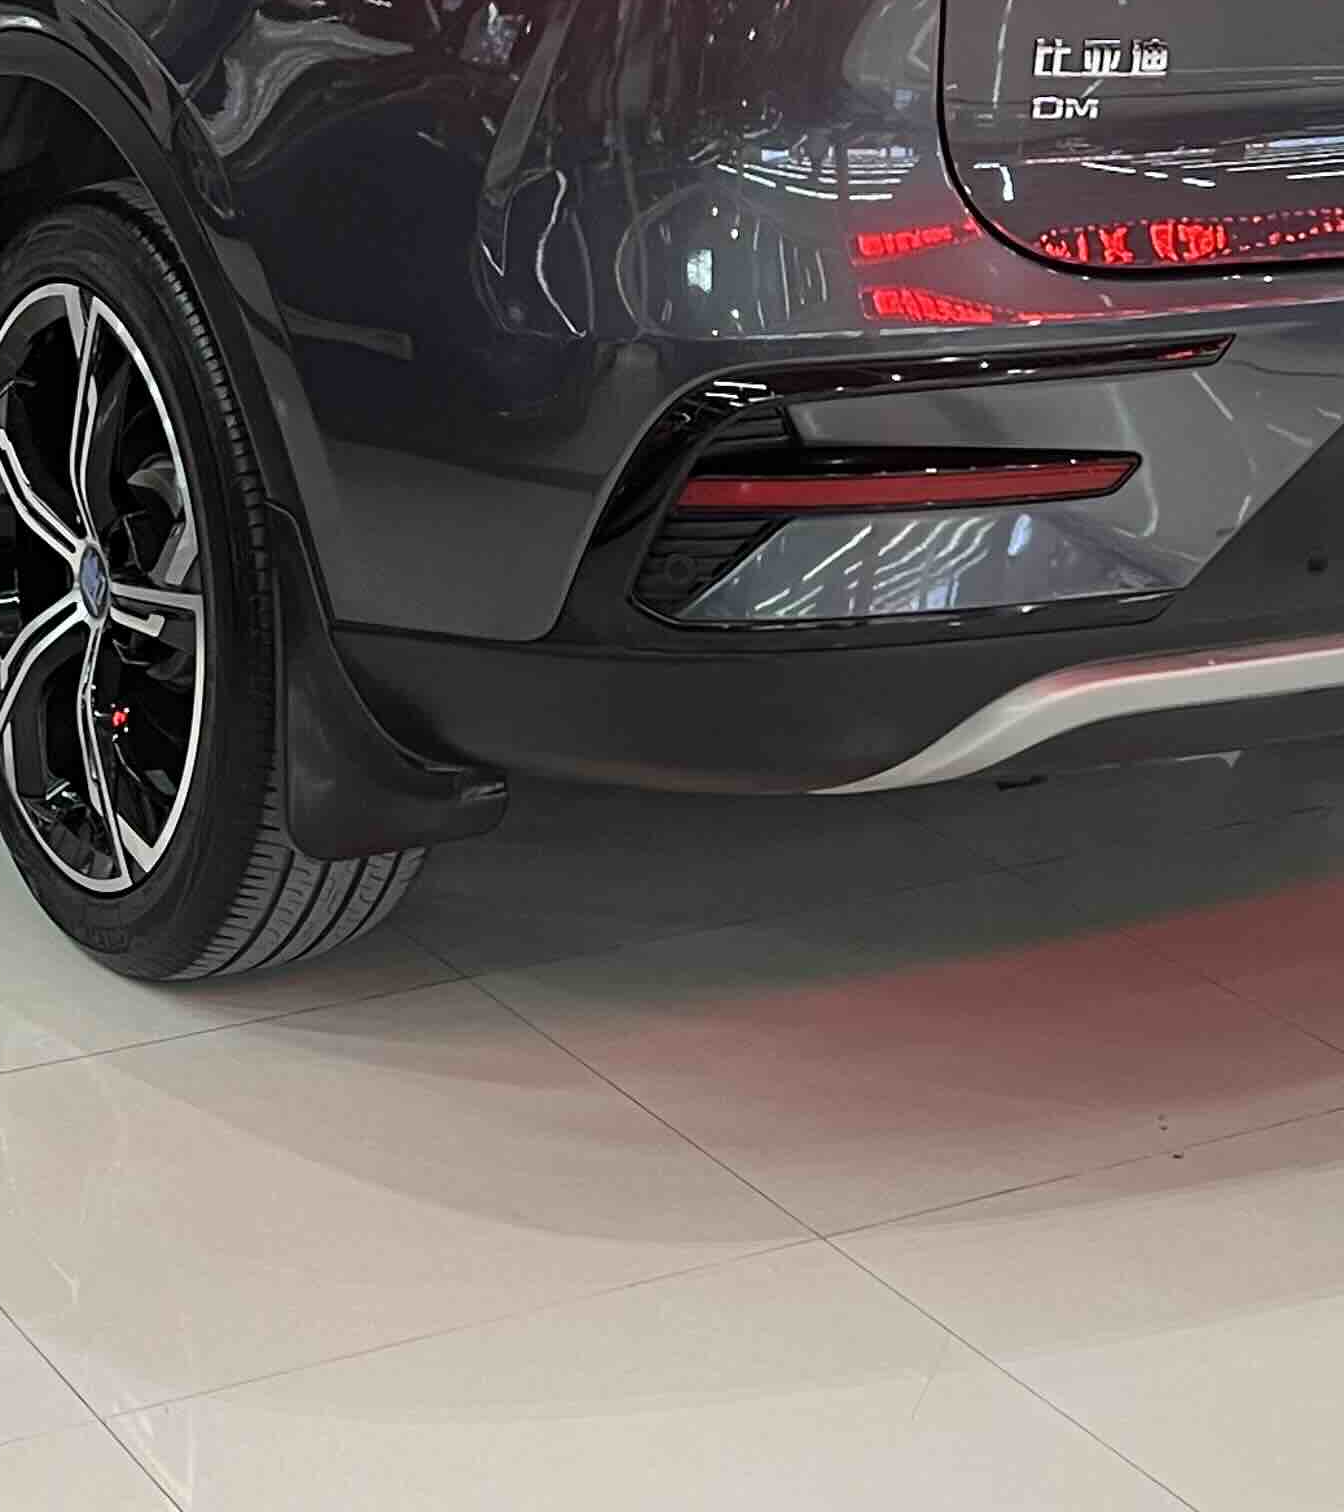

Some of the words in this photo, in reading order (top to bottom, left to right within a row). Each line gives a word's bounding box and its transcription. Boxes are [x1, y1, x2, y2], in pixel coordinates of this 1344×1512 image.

[1033, 37, 1169, 78] 比亚迪
[1032, 95, 1099, 120] DM
